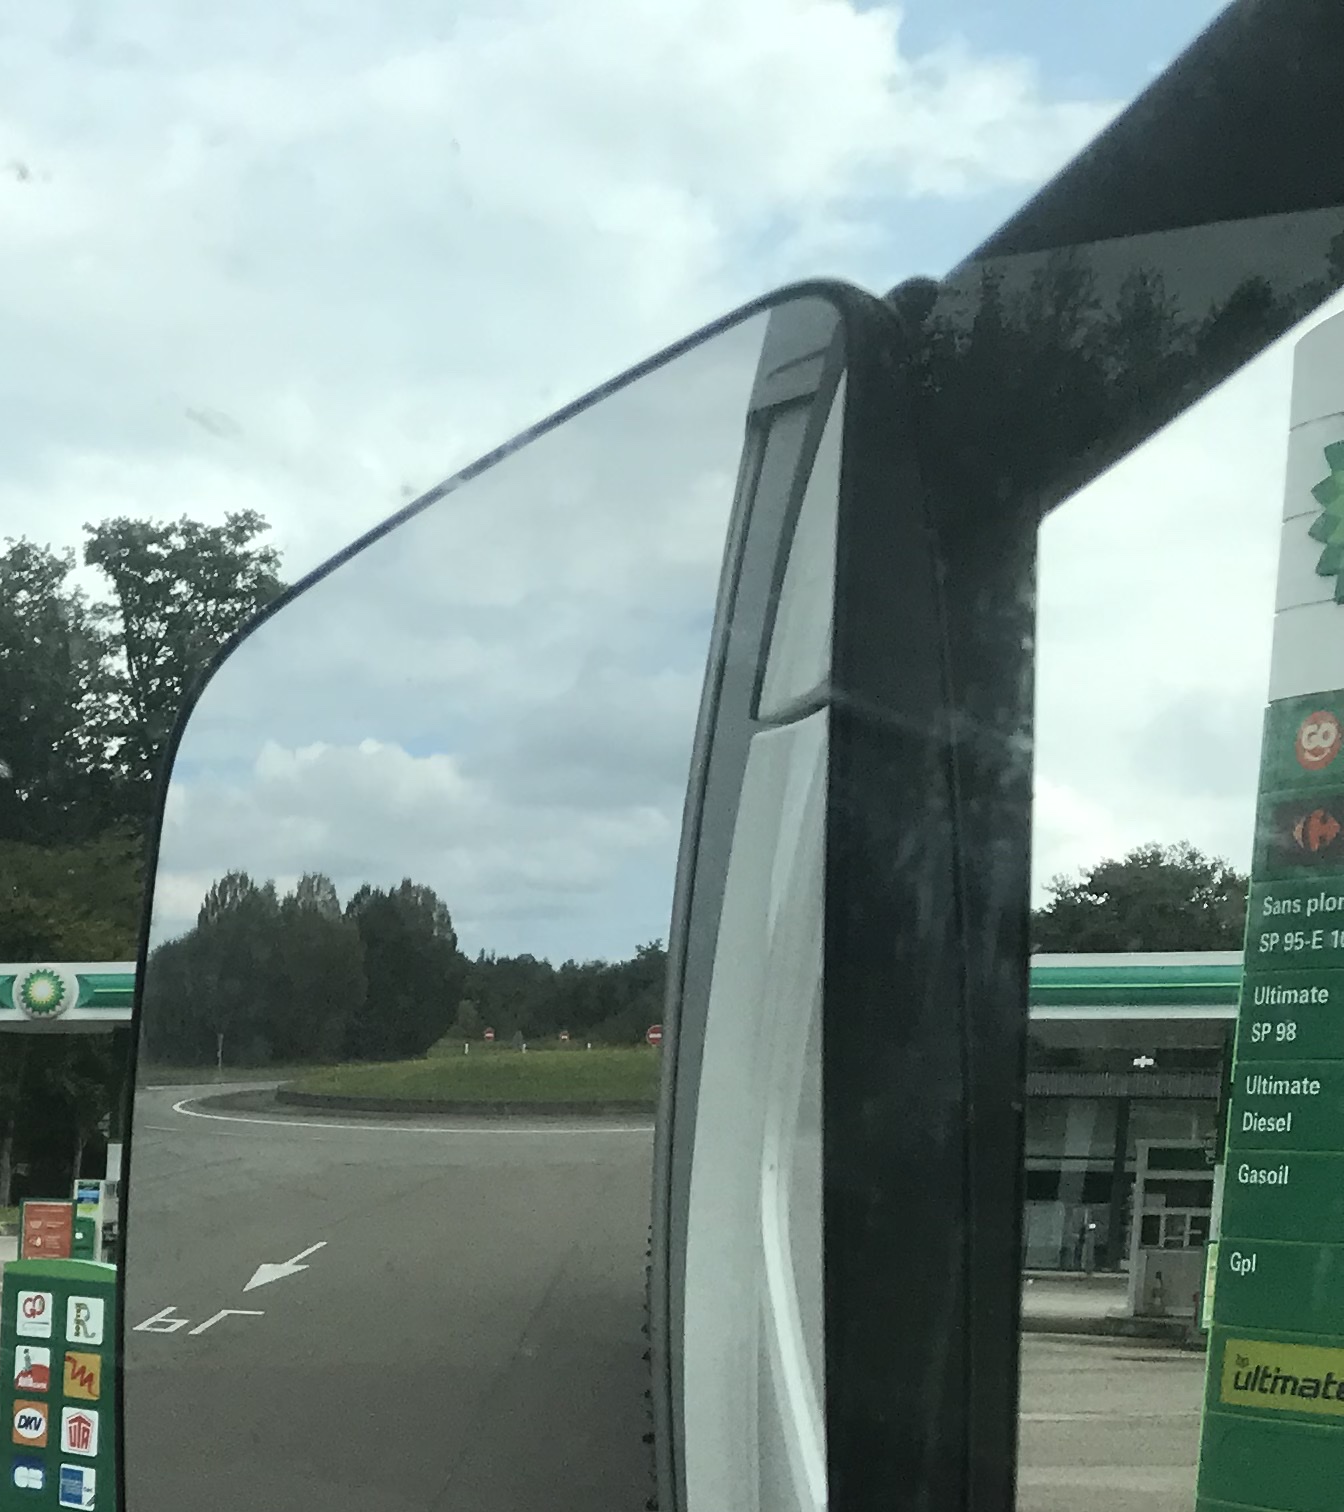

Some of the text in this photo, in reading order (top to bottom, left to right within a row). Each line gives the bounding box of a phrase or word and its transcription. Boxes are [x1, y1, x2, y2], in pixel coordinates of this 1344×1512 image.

[1263, 896, 1301, 916] Sans
[1259, 932, 1280, 952] SP
[1284, 930, 1323, 951] 95-E
[1254, 985, 1329, 1005] Ultimate
[1252, 1022, 1297, 1042] SP 98
[1246, 1075, 1321, 1095] Ultimate
[1242, 1111, 1292, 1132] Diesel
[1238, 1163, 1289, 1184] Gasoil
[1229, 1251, 1257, 1275] Gpl
[17, 1415, 42, 1431] DKV
